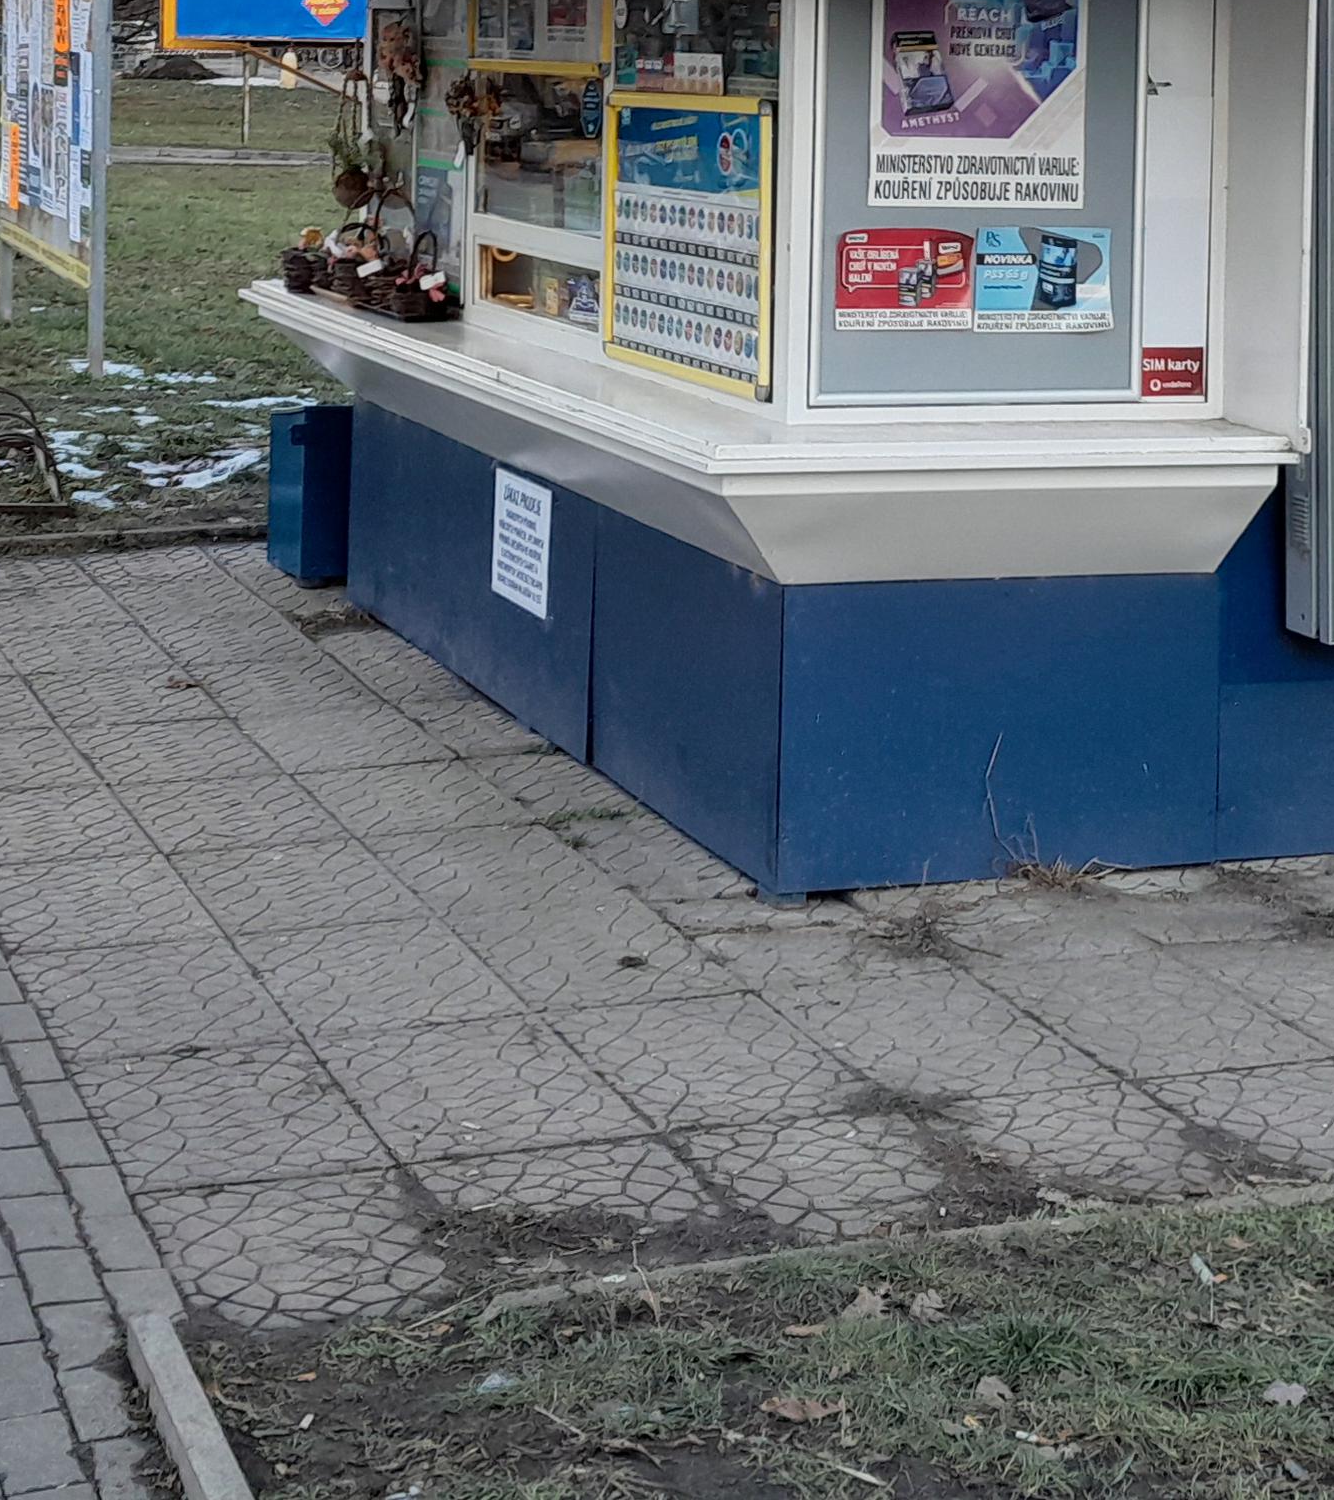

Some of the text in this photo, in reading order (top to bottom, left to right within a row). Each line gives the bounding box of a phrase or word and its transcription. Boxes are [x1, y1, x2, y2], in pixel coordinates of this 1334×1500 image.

[957, 8, 1012, 21] REACH
[900, 111, 961, 129] AMETHYST
[875, 152, 1080, 177] MINISTERSTVO ZDRAVOTNICTVÍ VARUJE:
[874, 176, 1079, 202] KOUŘENÍ ZPŮSOBUJE RAKOVINU
[983, 254, 1034, 265] NOVINKA
[1142, 357, 1200, 373] SIM karty
